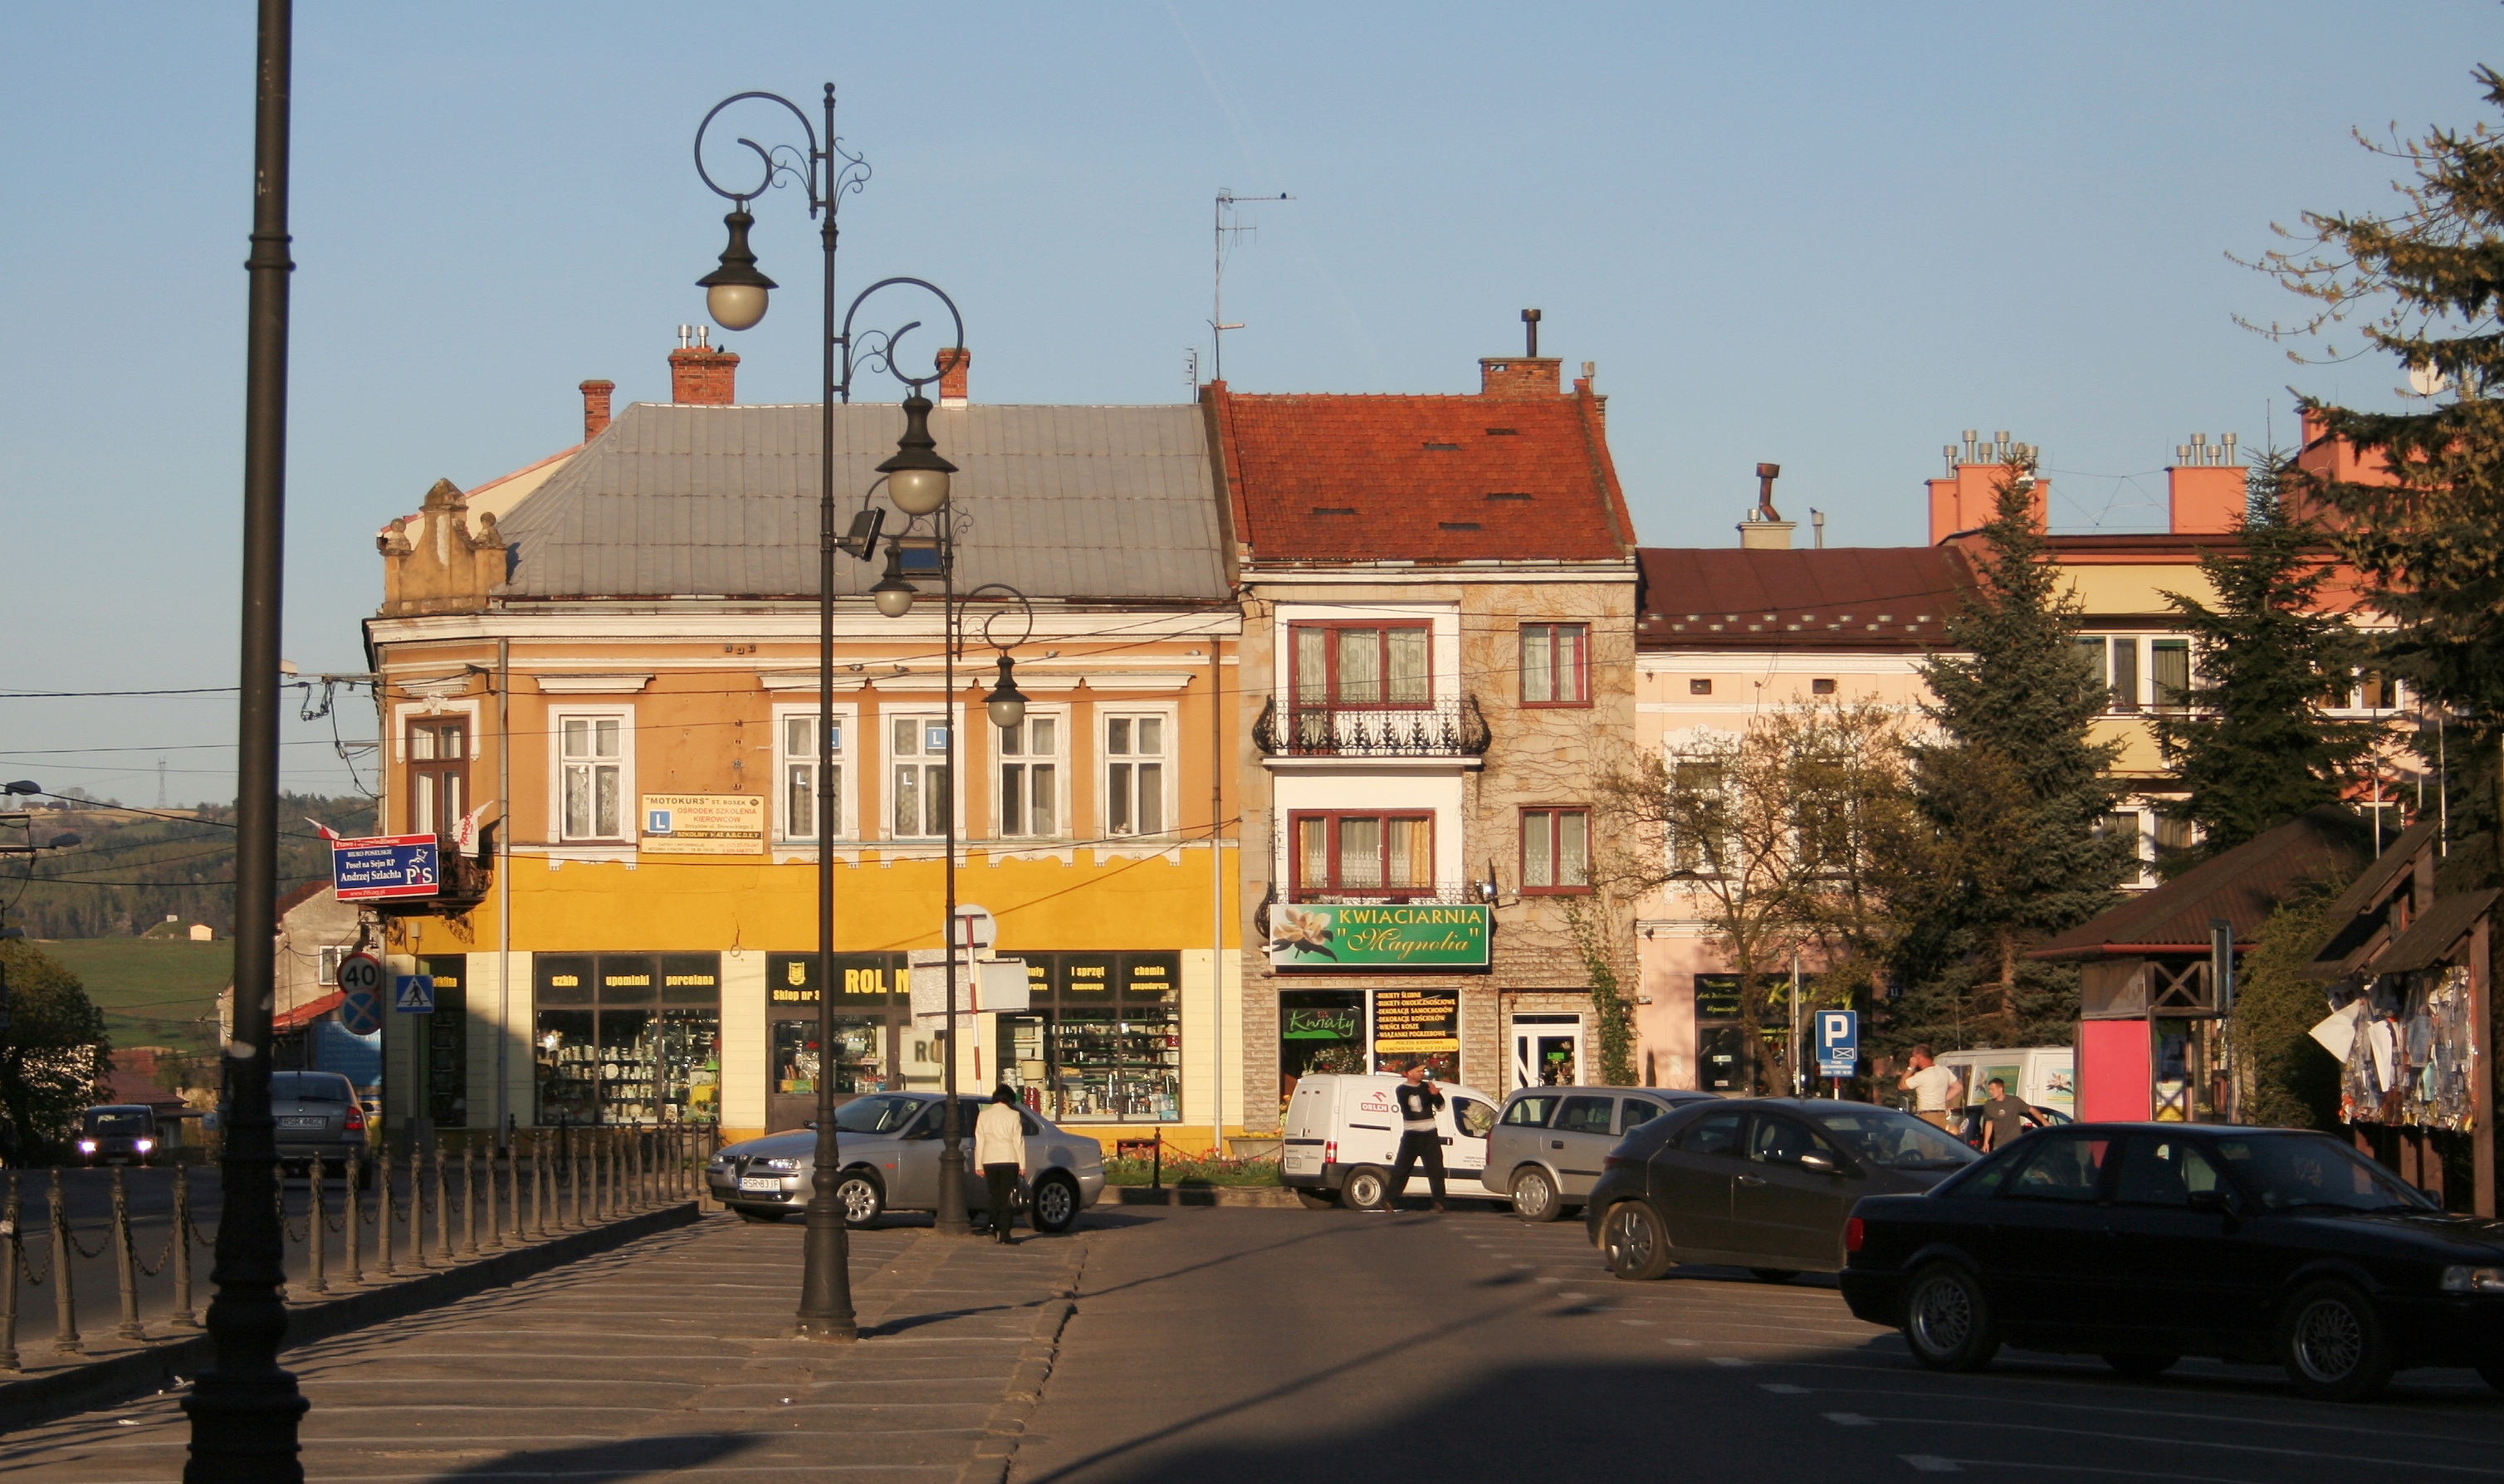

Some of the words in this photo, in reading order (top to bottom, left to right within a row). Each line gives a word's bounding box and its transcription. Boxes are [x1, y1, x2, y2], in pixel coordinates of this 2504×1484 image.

[796, 772, 806, 785] L
[903, 772, 912, 785] L
[656, 813, 666, 828] L
[370, 860, 386, 868] Sejm
[340, 871, 370, 882] Andrzej
[371, 870, 402, 880] Szlachta
[1339, 909, 1482, 924] KWIACIARNIA
[345, 964, 375, 987] 40
[1077, 966, 1105, 979] sprzęt
[1134, 966, 1166, 976] chemia
[605, 974, 649, 987] upominki
[666, 974, 715, 987] porcelana
[773, 989, 800, 1001] Sklep
[801, 990, 814, 1000] nr
[1289, 1010, 1355, 1038] Kwiaty
[1825, 1014, 1848, 1047] P
